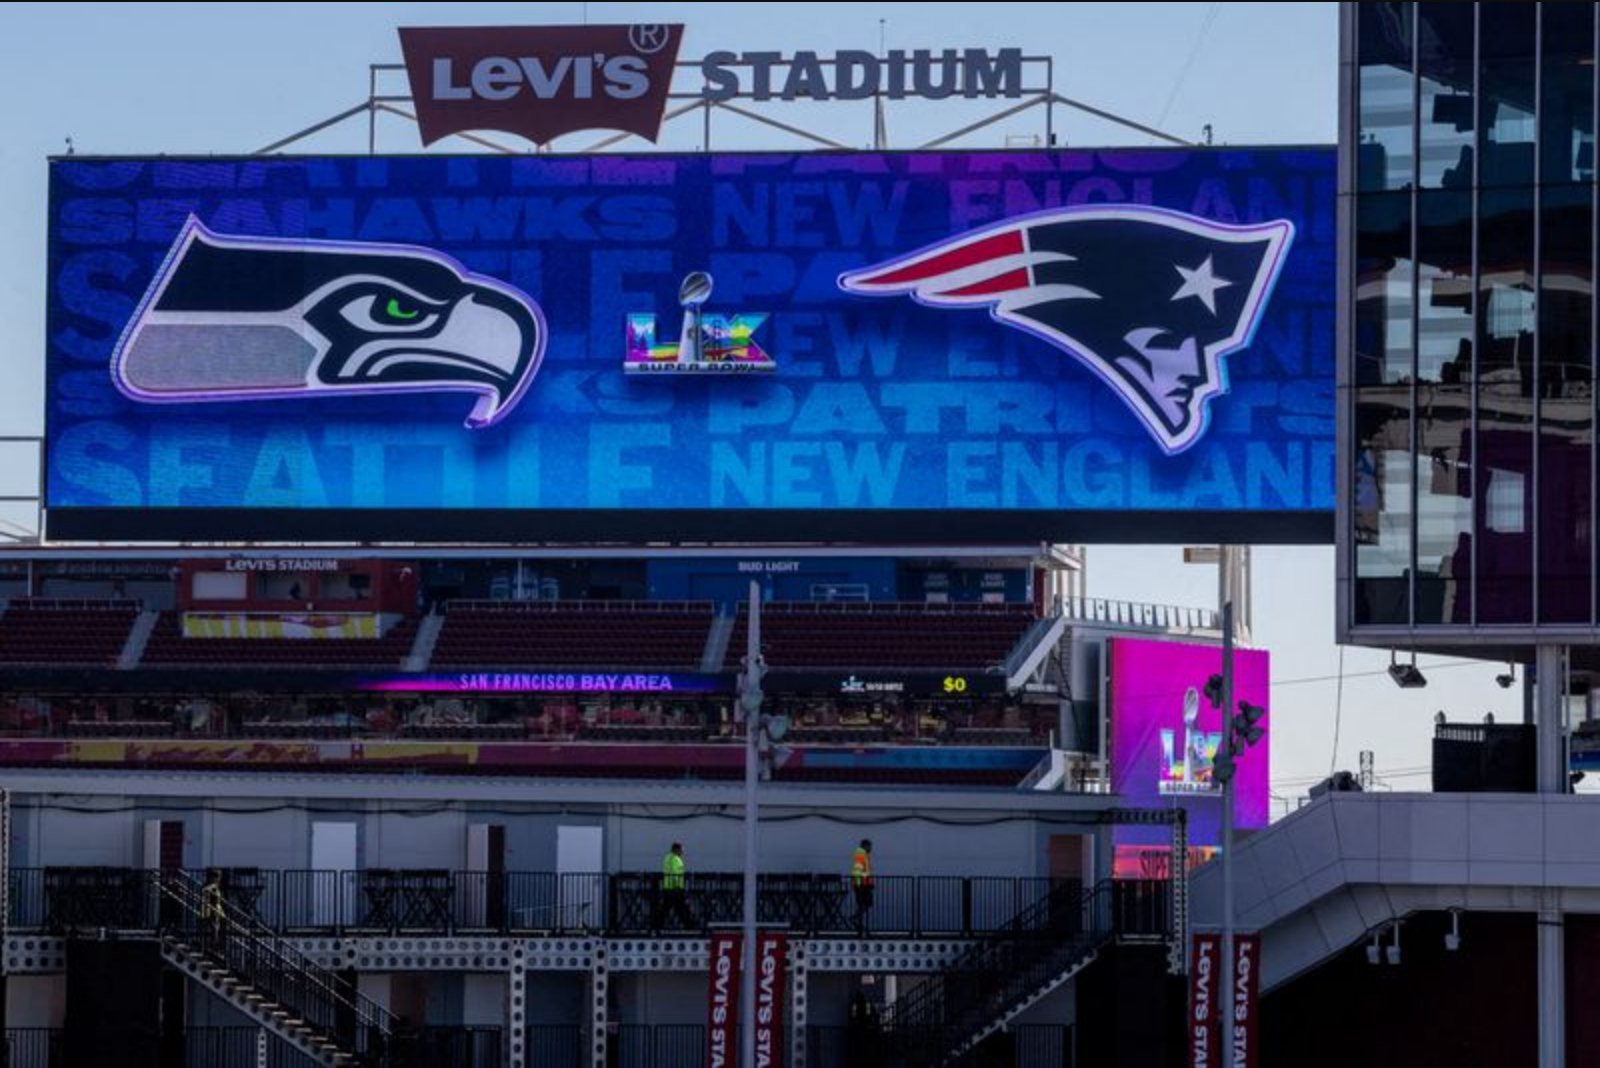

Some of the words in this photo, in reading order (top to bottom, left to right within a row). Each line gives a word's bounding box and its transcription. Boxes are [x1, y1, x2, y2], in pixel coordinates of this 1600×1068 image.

[700, 48, 1022, 102] STADIUM
[712, 180, 908, 247] NEW
[639, 362, 701, 372] SUPER
[707, 362, 757, 372] BOWL
[706, 381, 1335, 435] PATRITS
[54, 420, 671, 507] SEATTLE
[708, 441, 907, 508] NEW
[277, 559, 338, 571] STADIUM
[765, 561, 799, 572] LIGHT
[459, 673, 488, 690] SAN
[494, 673, 575, 690] FRANCISCO
[581, 675, 616, 690] BAY
[621, 675, 672, 690] AREA
[943, 675, 967, 693] $0
